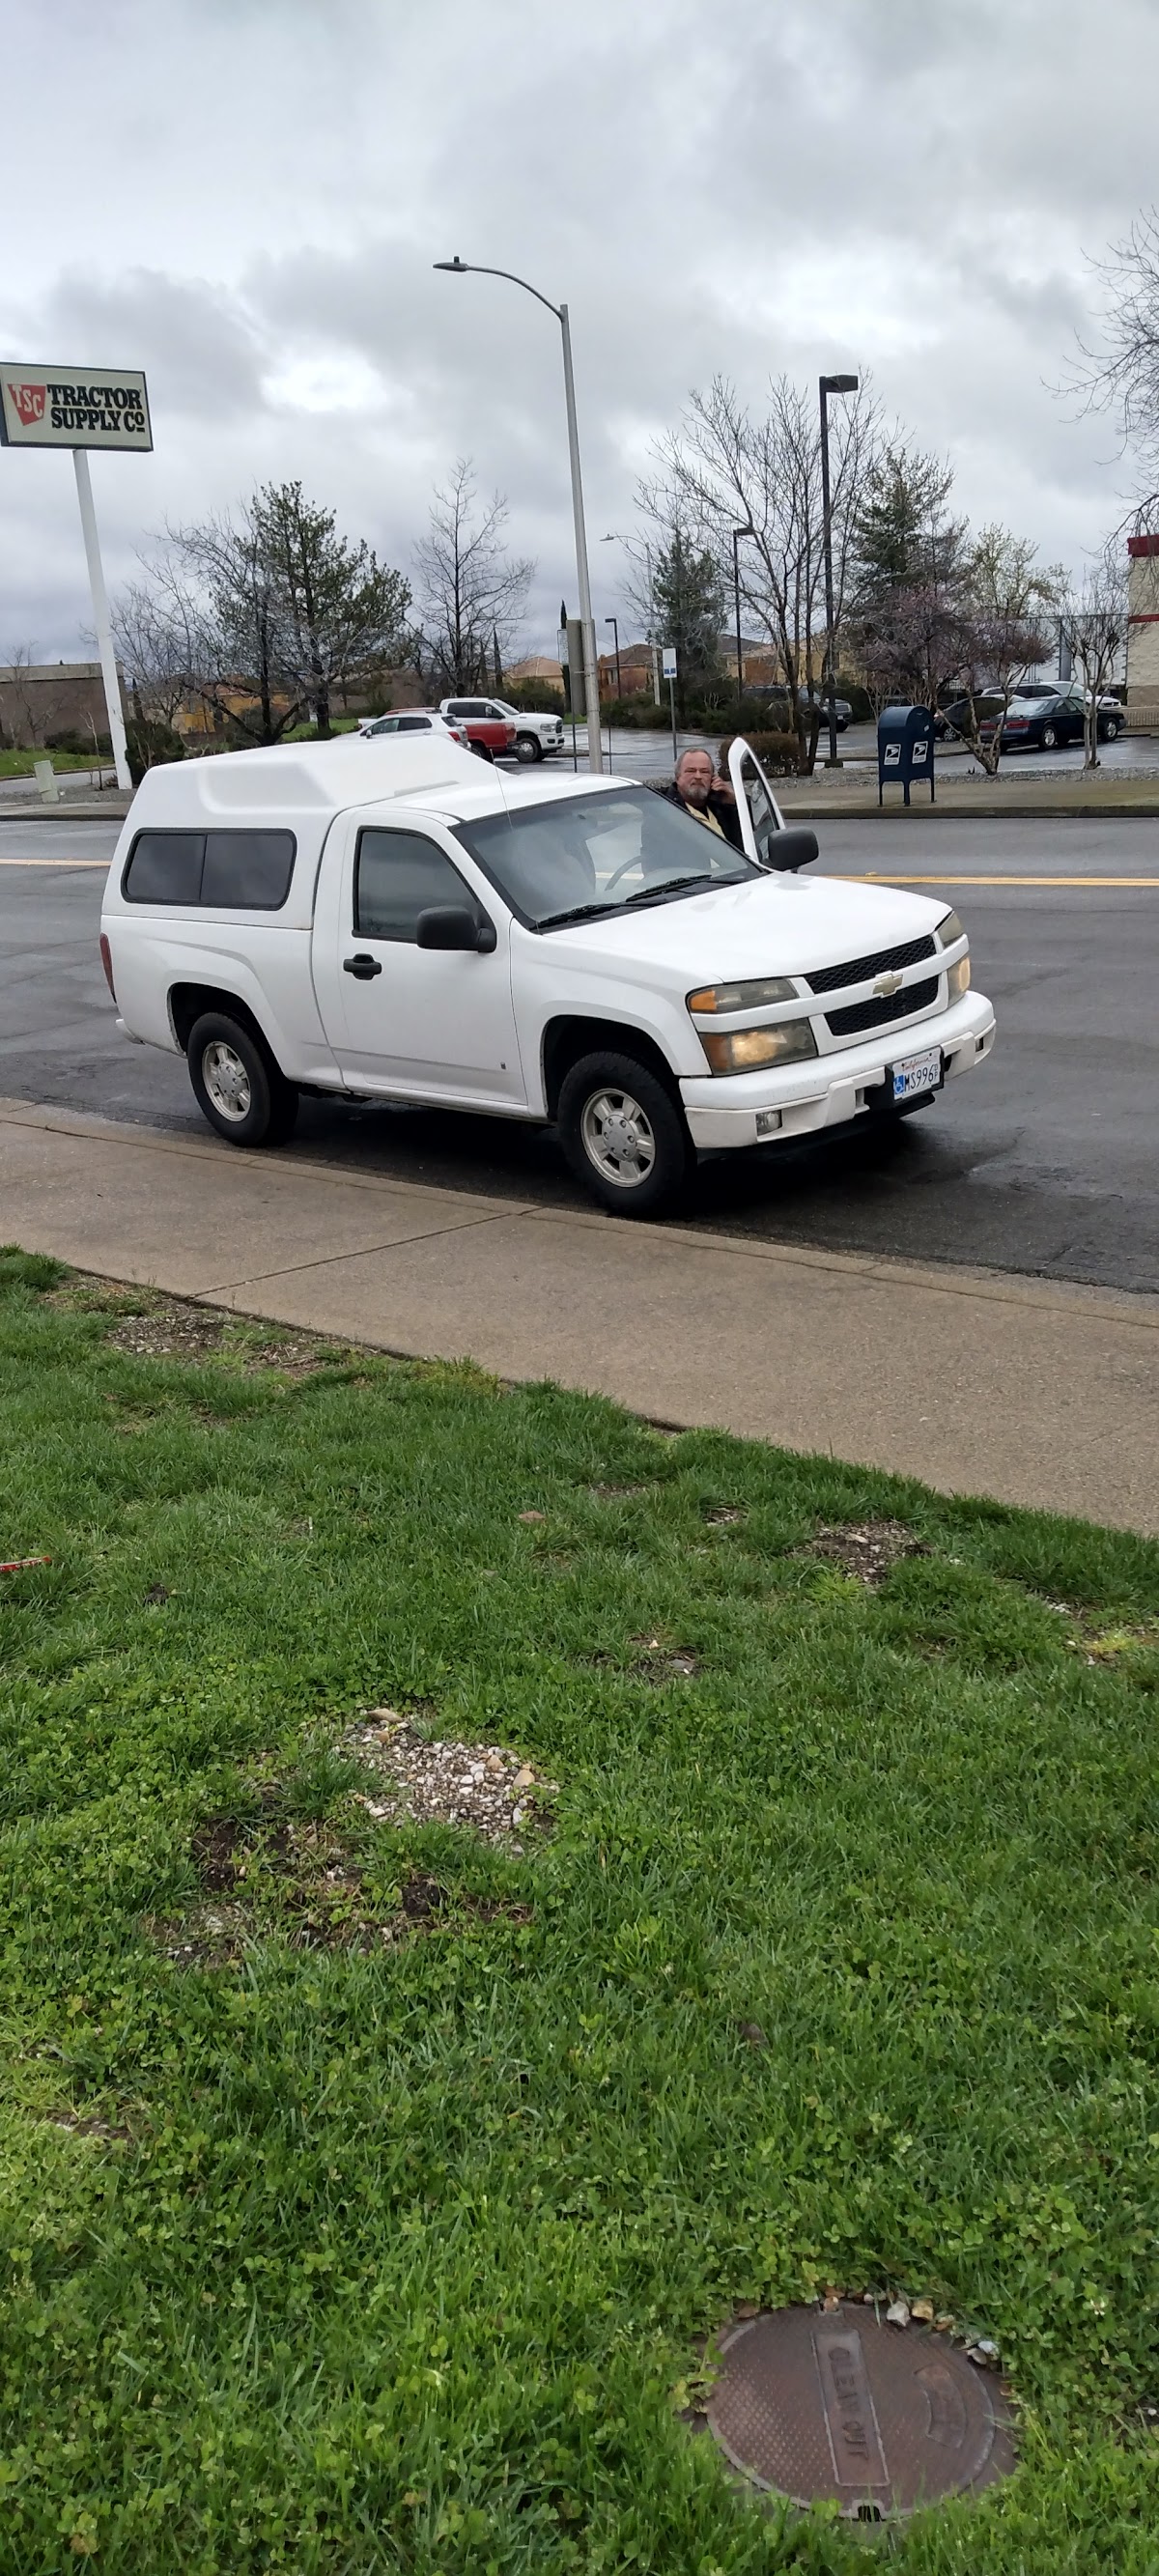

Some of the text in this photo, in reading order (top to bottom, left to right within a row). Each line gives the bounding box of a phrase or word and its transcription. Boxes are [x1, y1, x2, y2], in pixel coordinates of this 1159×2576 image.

[13, 384, 43, 418] TSC
[46, 383, 143, 410] TRACTOR
[51, 407, 121, 431] SUPPLY
[842, 2420, 868, 2461] OUT
